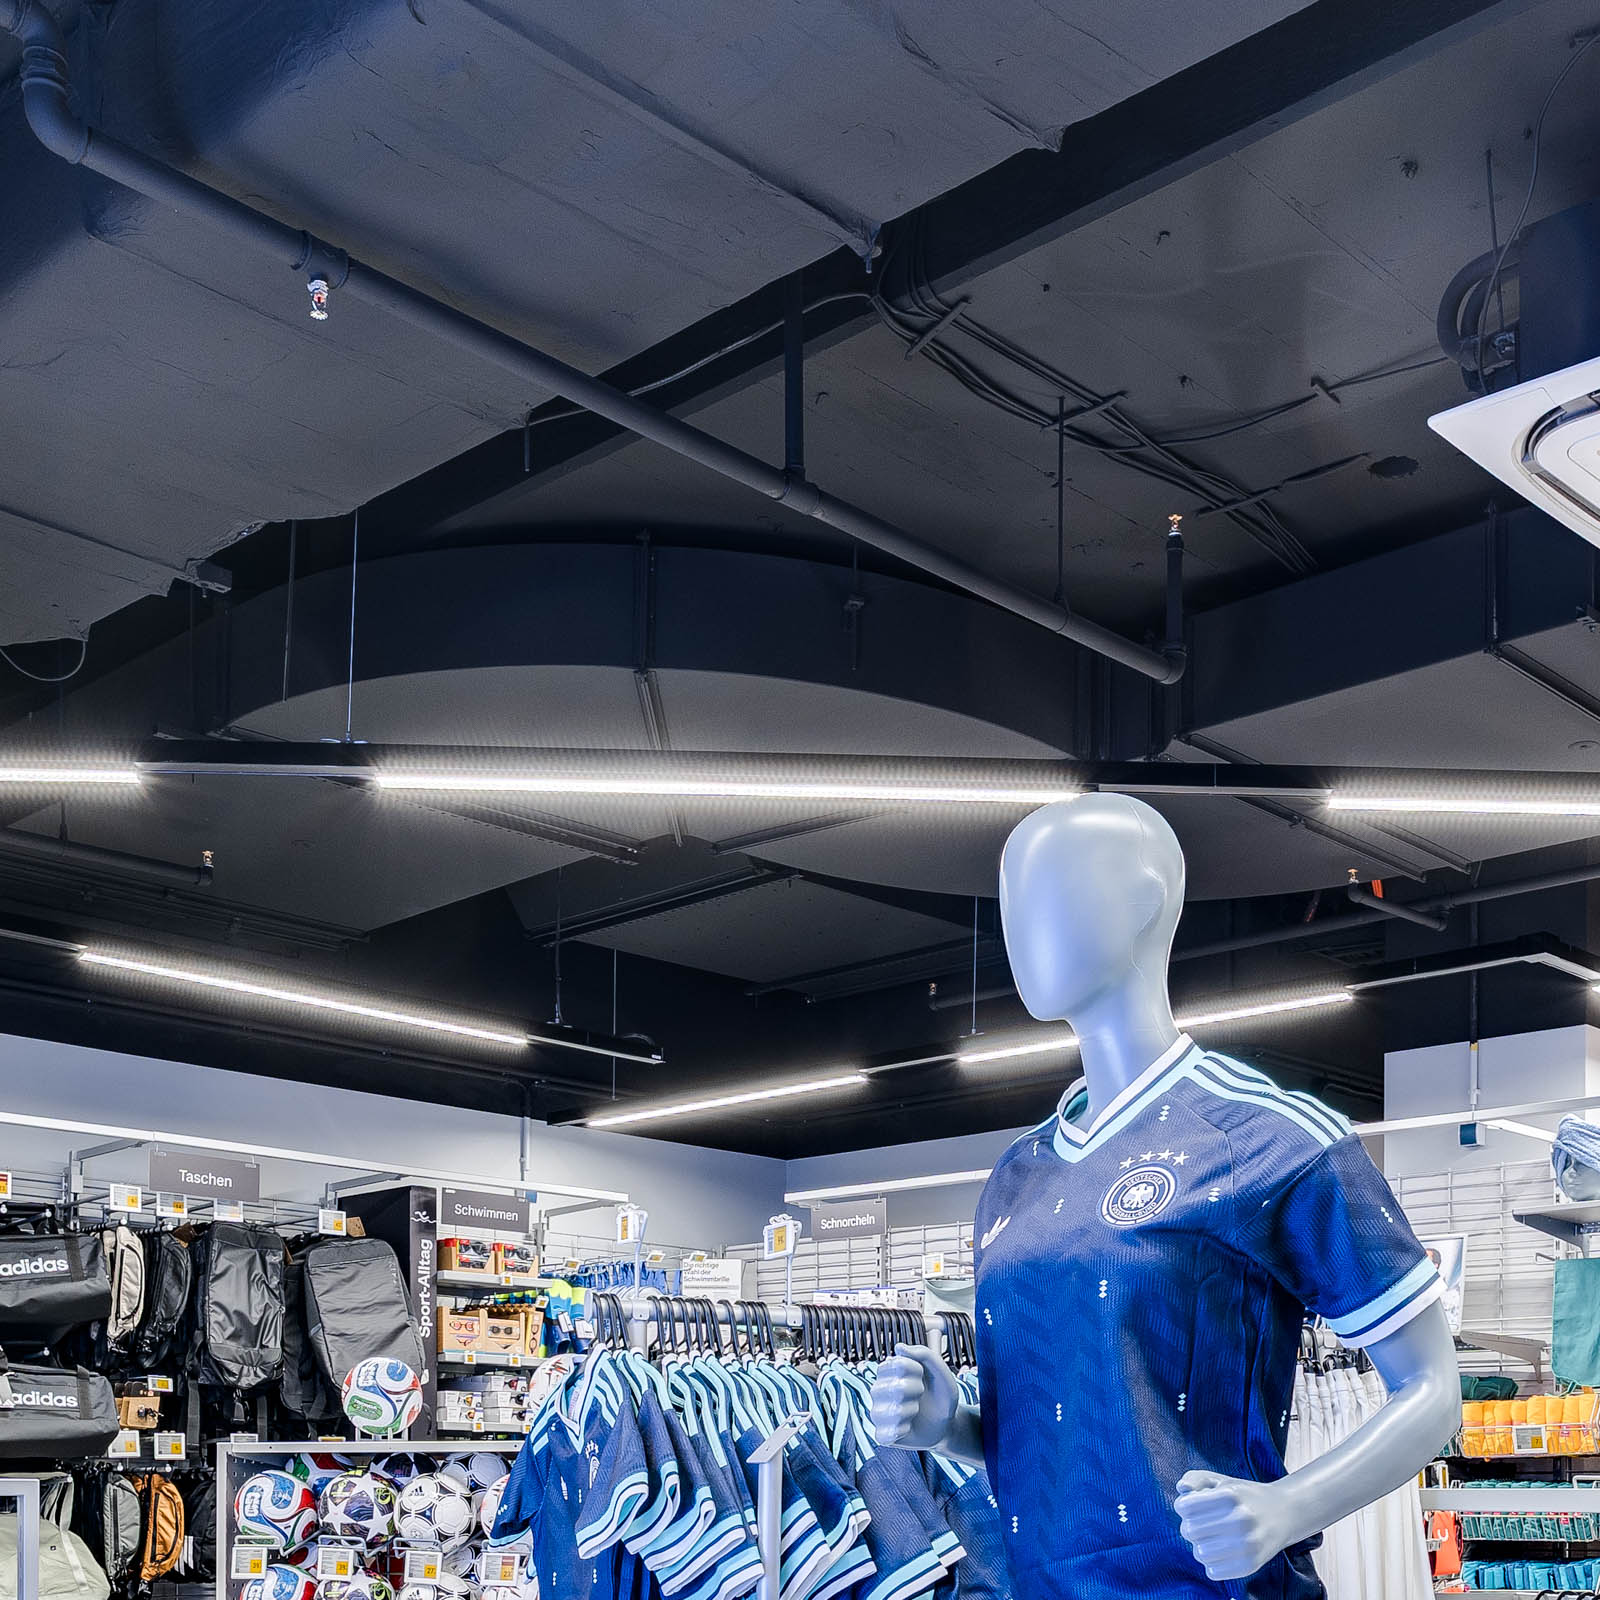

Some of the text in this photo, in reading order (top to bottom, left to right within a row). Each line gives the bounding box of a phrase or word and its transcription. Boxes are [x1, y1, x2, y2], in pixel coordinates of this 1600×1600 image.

[178, 1168, 233, 1188] Taschen
[454, 1203, 519, 1222] Schwimmen
[820, 1213, 876, 1230] Schnorcheln
[418, 1238, 434, 1339] Sport-Alltag
[12, 1391, 79, 1408] adidas
